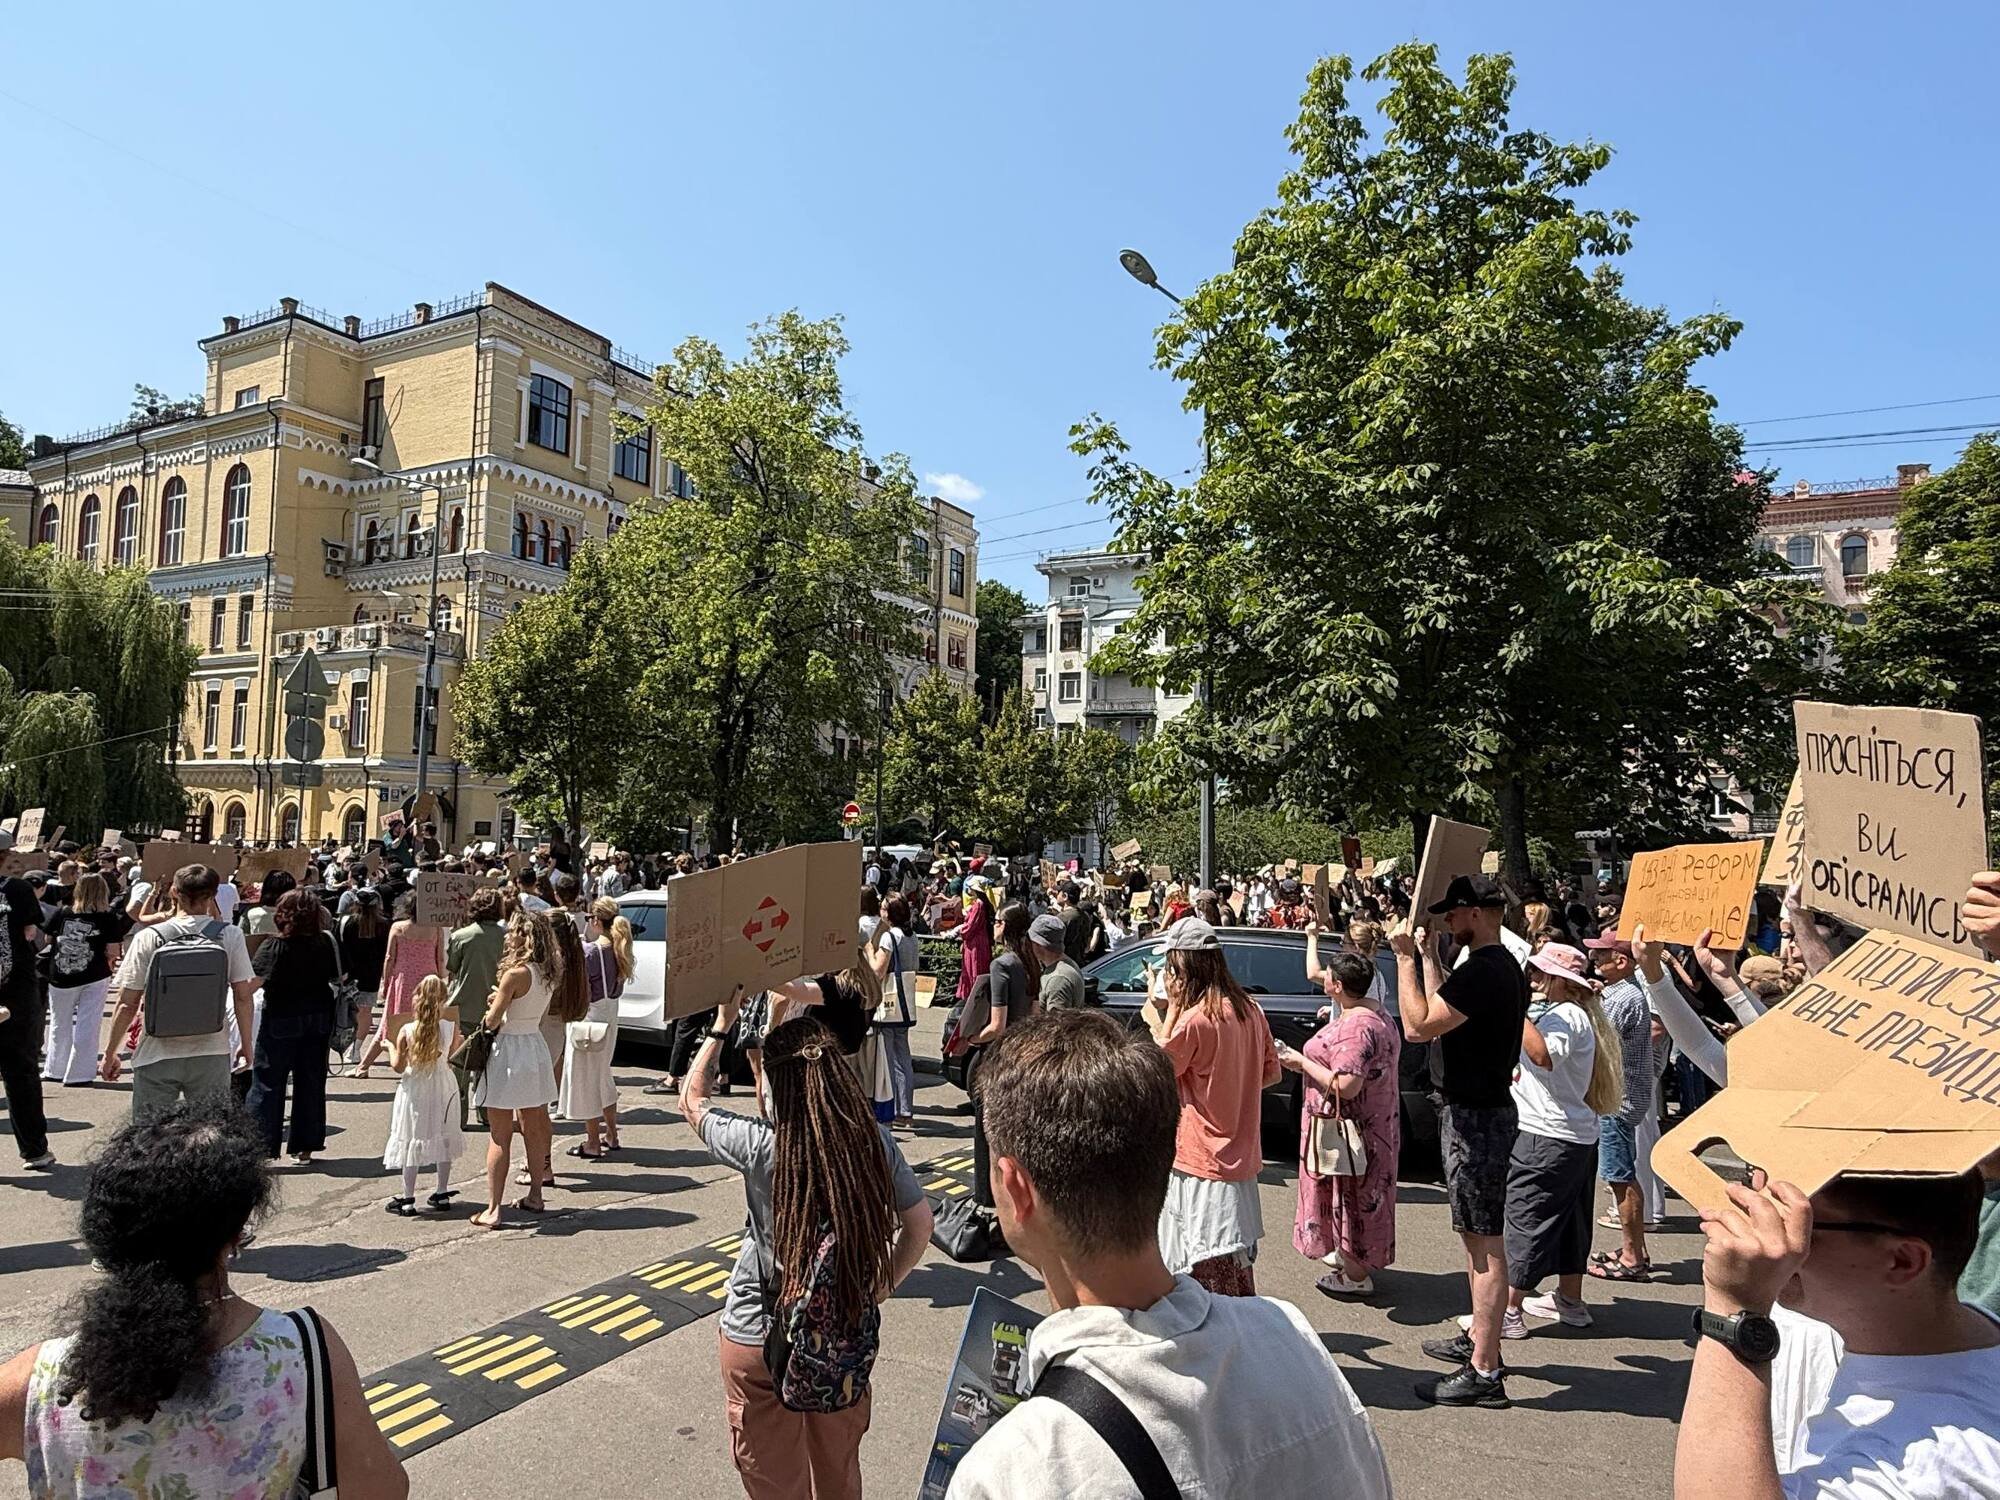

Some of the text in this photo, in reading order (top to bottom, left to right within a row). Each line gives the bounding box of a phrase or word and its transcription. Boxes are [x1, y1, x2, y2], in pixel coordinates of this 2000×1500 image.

[1857, 813, 1907, 861] ВИ
[1811, 856, 1968, 943] ОБІСРАЛИСЬ
[1779, 983, 1872, 1038] ПАНЕ
